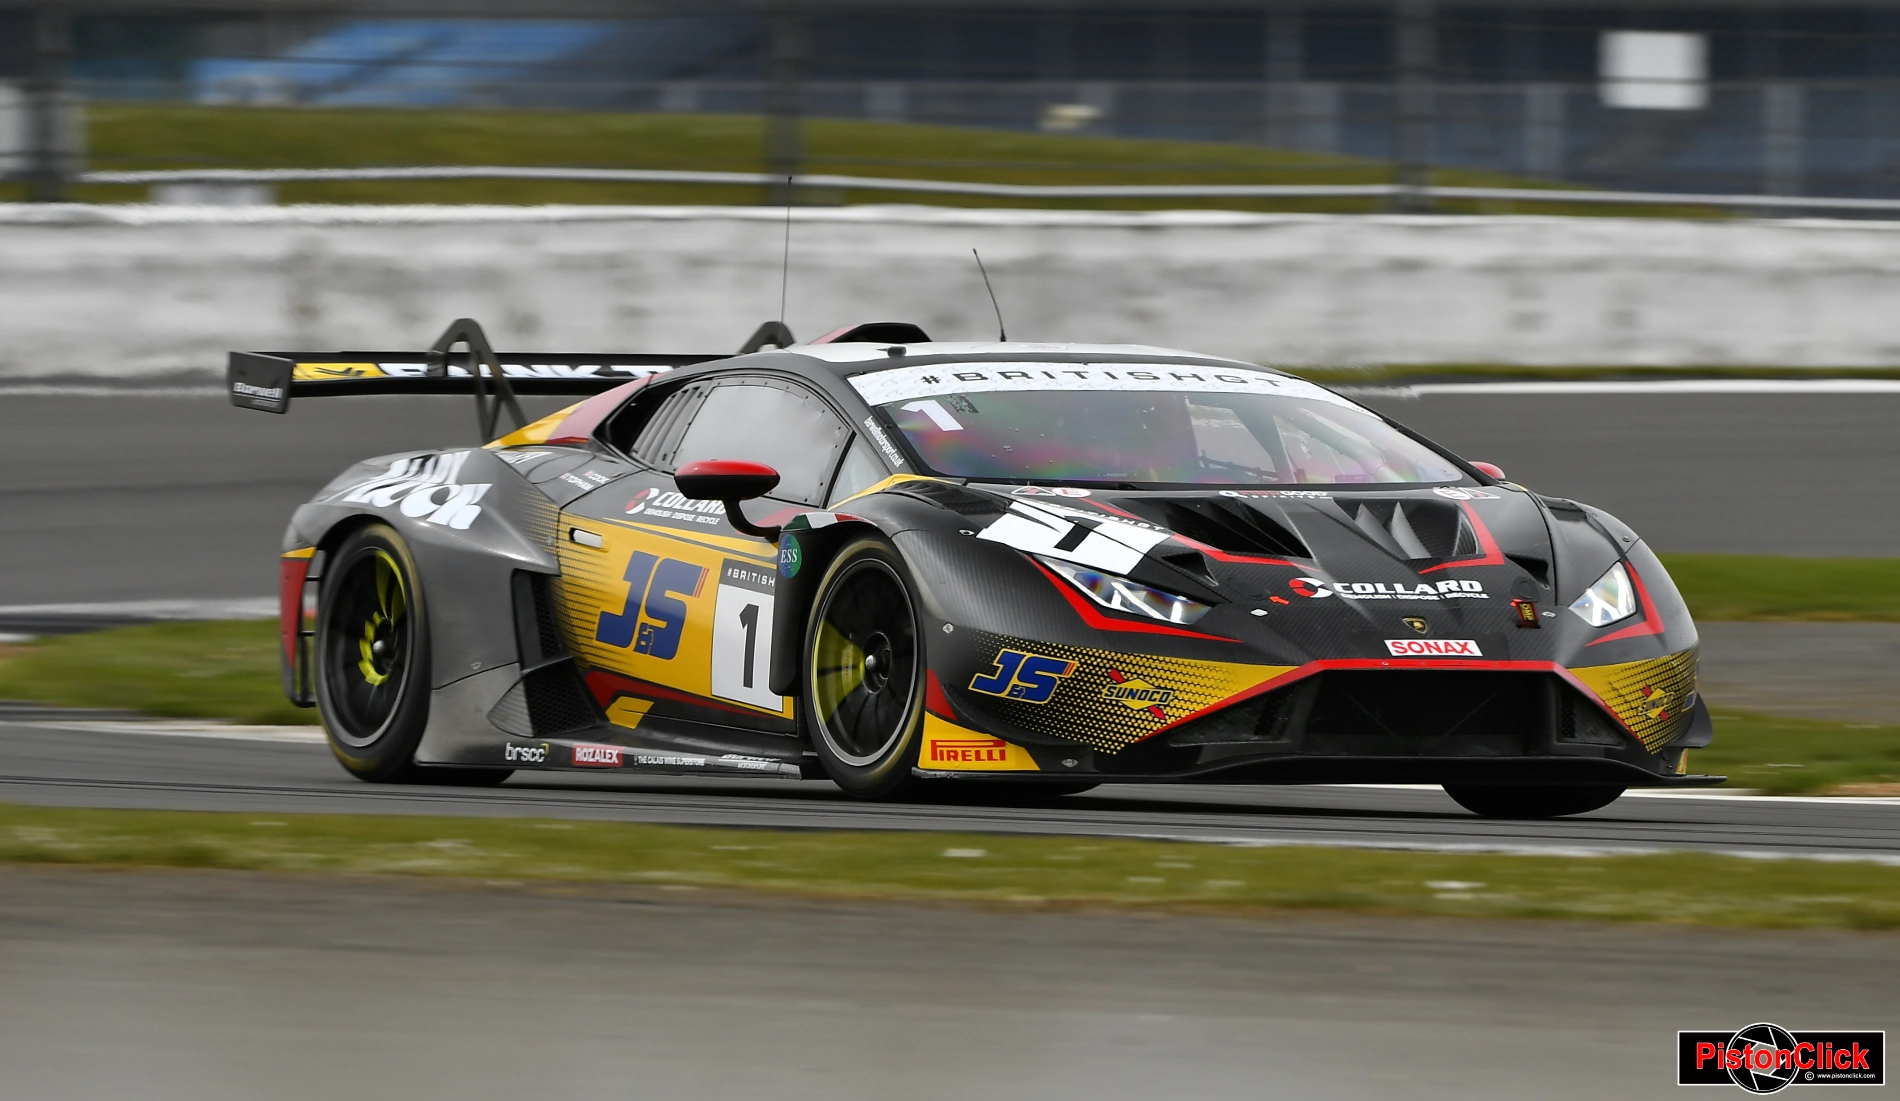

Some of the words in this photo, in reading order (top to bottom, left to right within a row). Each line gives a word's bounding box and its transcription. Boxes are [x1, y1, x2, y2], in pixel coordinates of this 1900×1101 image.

[920, 369, 1281, 388] #BRITISHGT
[900, 400, 964, 431] 1
[695, 515, 721, 526] RECYCLE
[1053, 515, 1104, 553] 1
[780, 548, 798, 564] ESS
[1332, 579, 1484, 595] COLLARD
[738, 603, 760, 689] 1
[1390, 641, 1475, 655] SONAX
[1103, 685, 1173, 704] SUNOCO
[504, 742, 546, 763] brscc
[575, 747, 619, 764] ROZALEX
[930, 739, 1007, 761] PIRELLI
